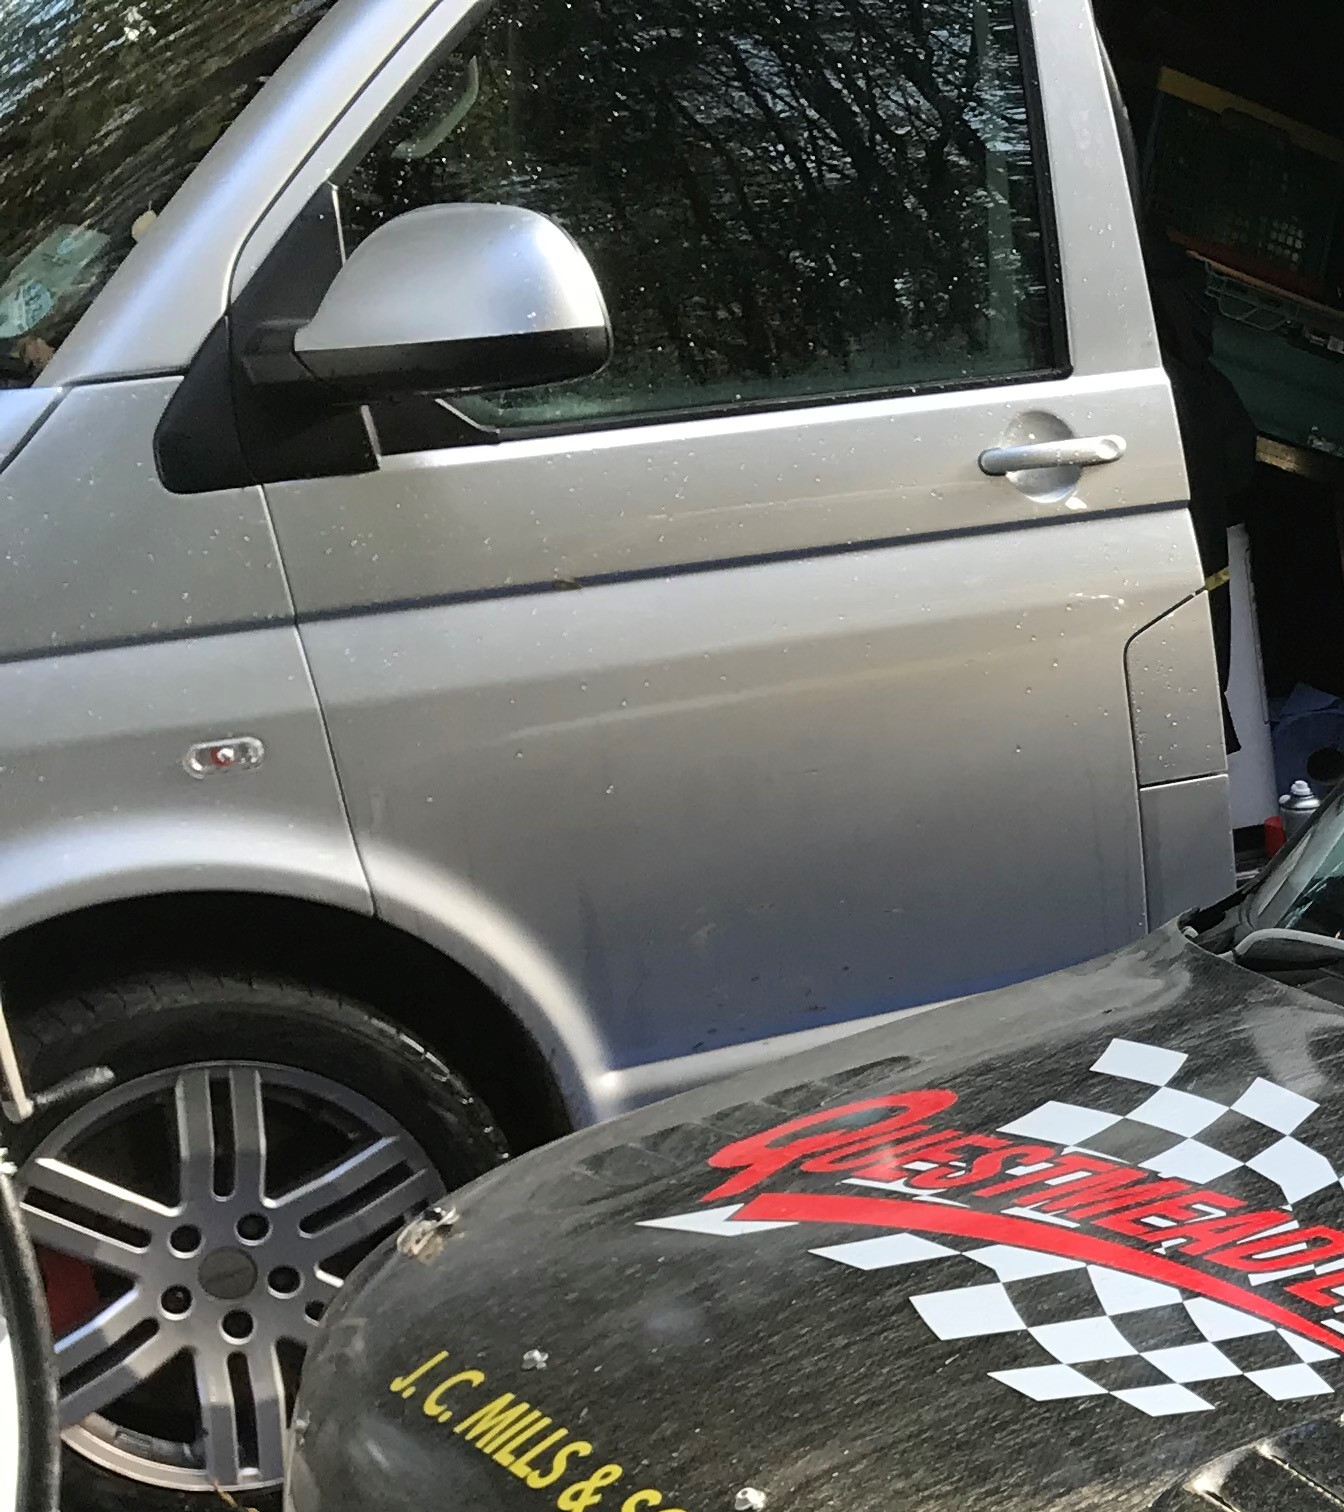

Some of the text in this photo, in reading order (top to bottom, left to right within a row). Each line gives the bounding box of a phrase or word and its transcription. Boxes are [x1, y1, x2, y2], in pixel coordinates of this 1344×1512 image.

[389, 1350, 450, 1399] J.
[423, 1369, 485, 1424] C.
[453, 1392, 593, 1490] MILLS
